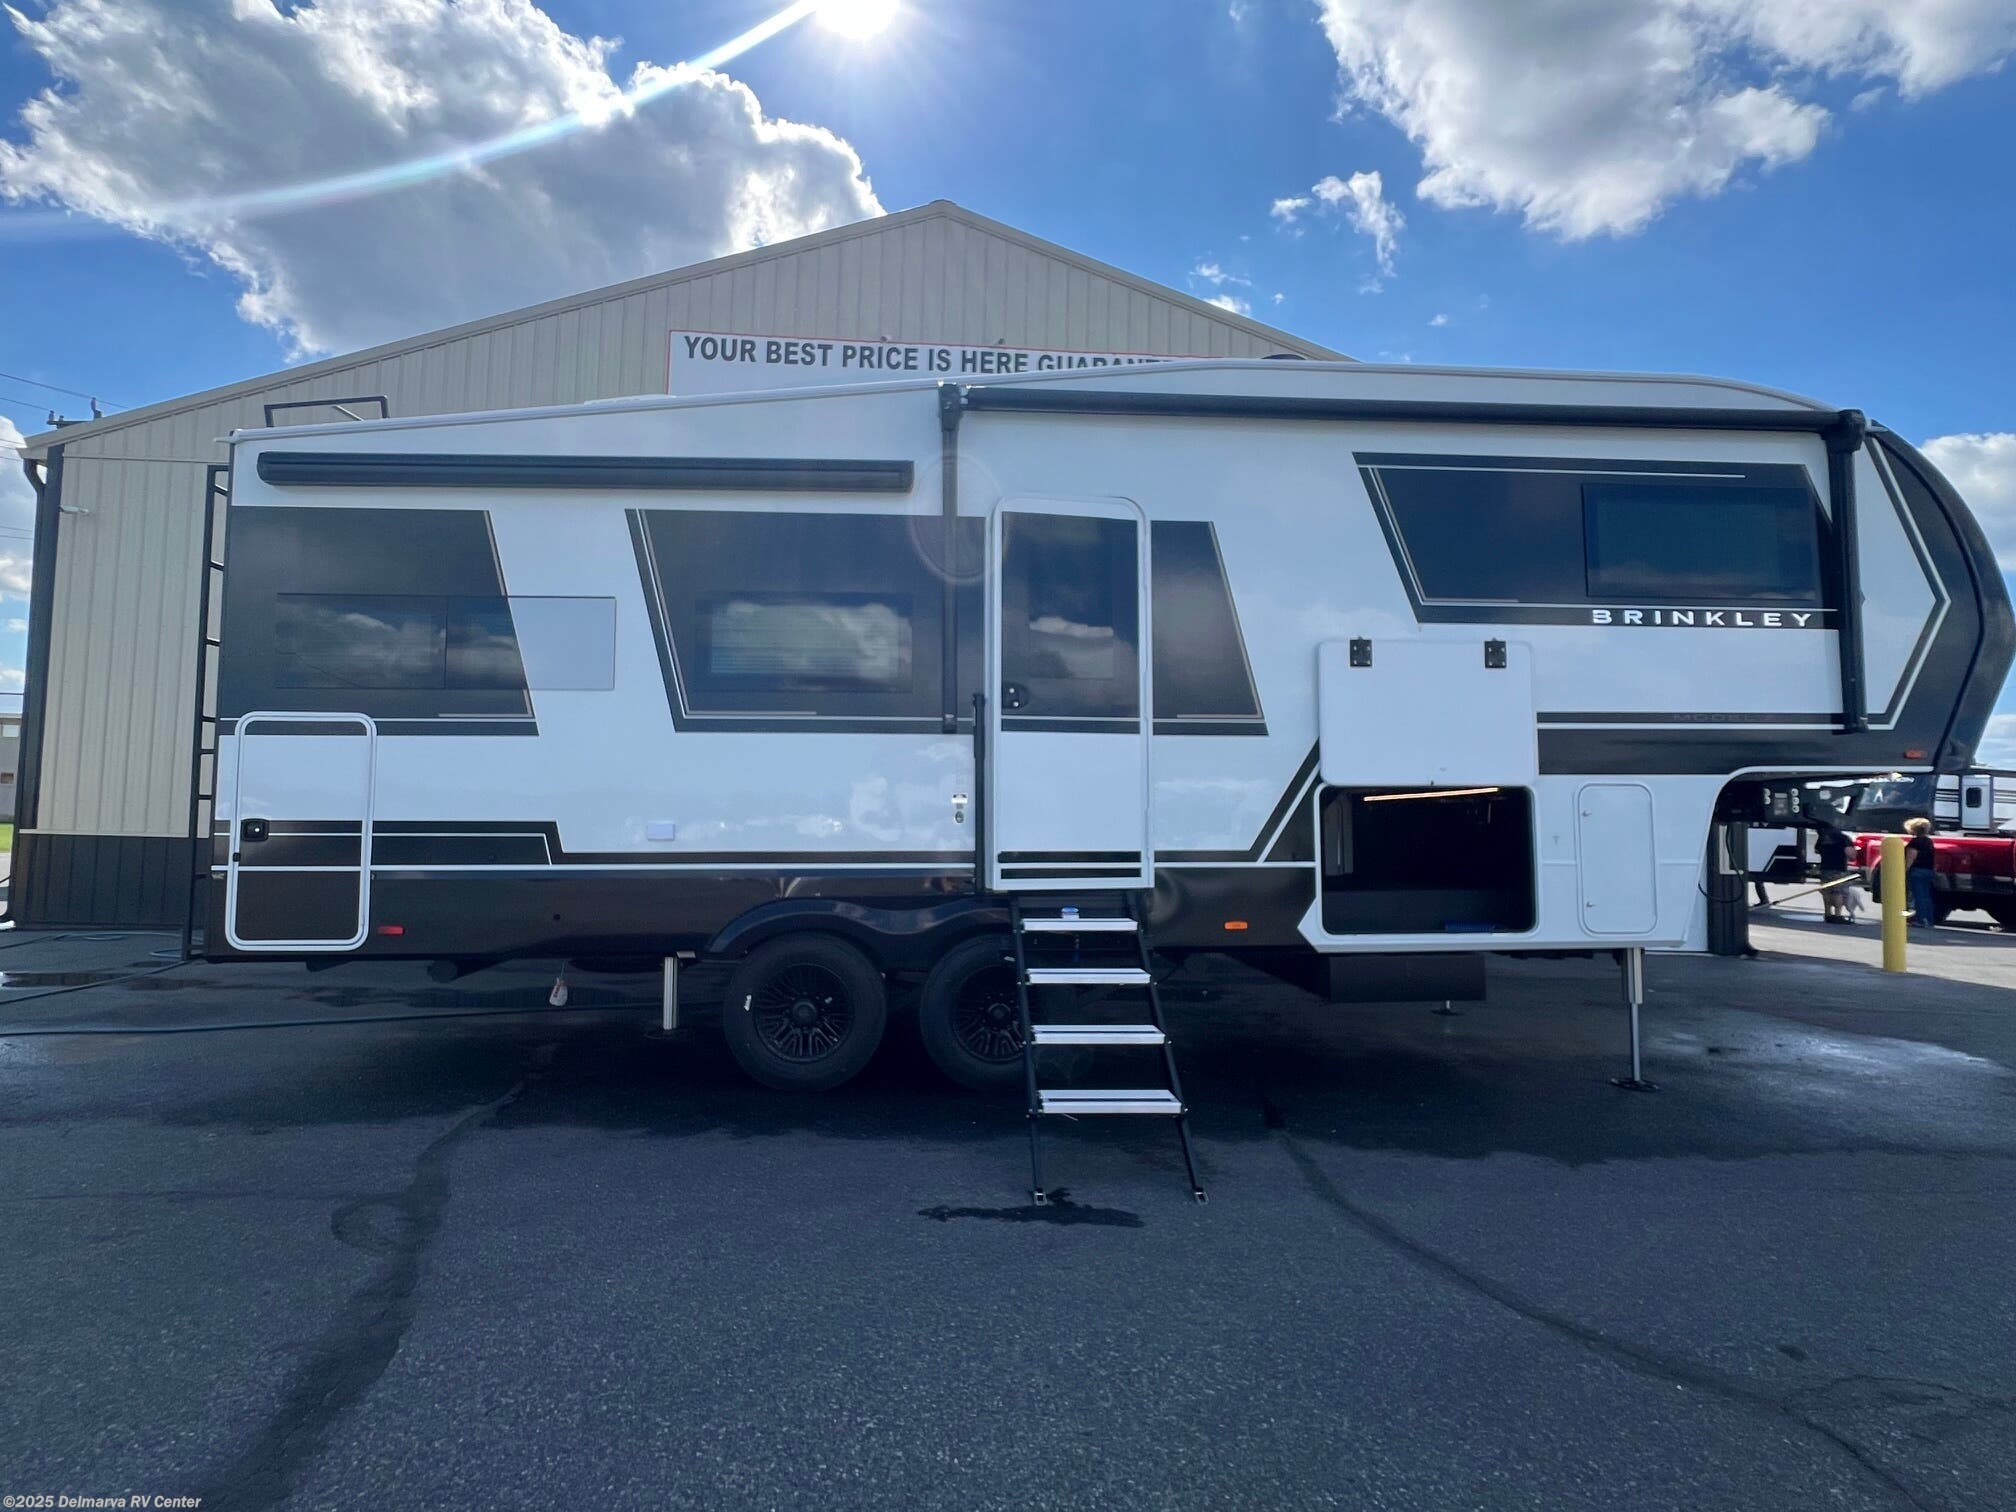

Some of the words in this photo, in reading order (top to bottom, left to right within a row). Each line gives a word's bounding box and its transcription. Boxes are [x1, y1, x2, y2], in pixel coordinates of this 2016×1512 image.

[684, 335, 757, 363] YOUR
[766, 340, 833, 367] BEST
[842, 344, 918, 371] PRICE
[929, 348, 951, 372] IS
[961, 350, 1029, 374] HERE
[1591, 609, 1812, 627] BRINKLEY
